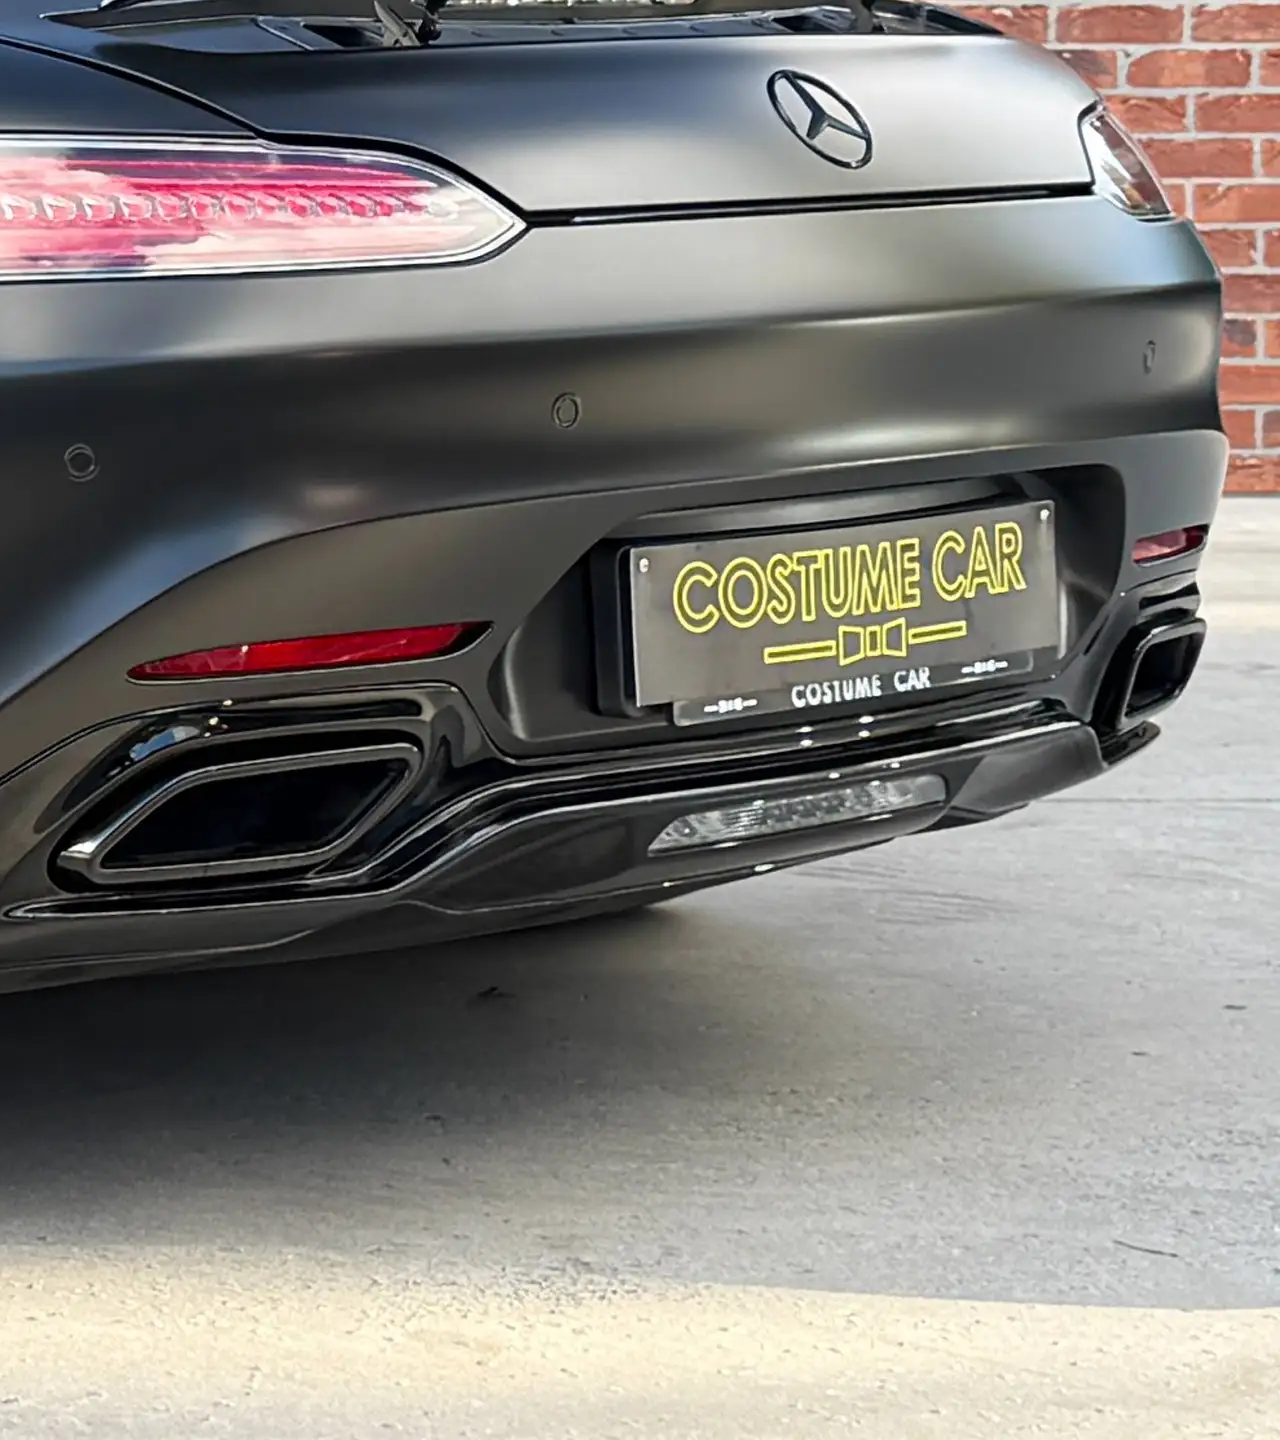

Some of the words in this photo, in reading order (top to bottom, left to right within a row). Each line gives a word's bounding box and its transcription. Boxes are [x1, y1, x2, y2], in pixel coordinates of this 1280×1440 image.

[673, 537, 921, 633] COSTUME
[932, 521, 1028, 601] CAR
[791, 674, 882, 708] COSTUME
[893, 666, 931, 692] CAR
